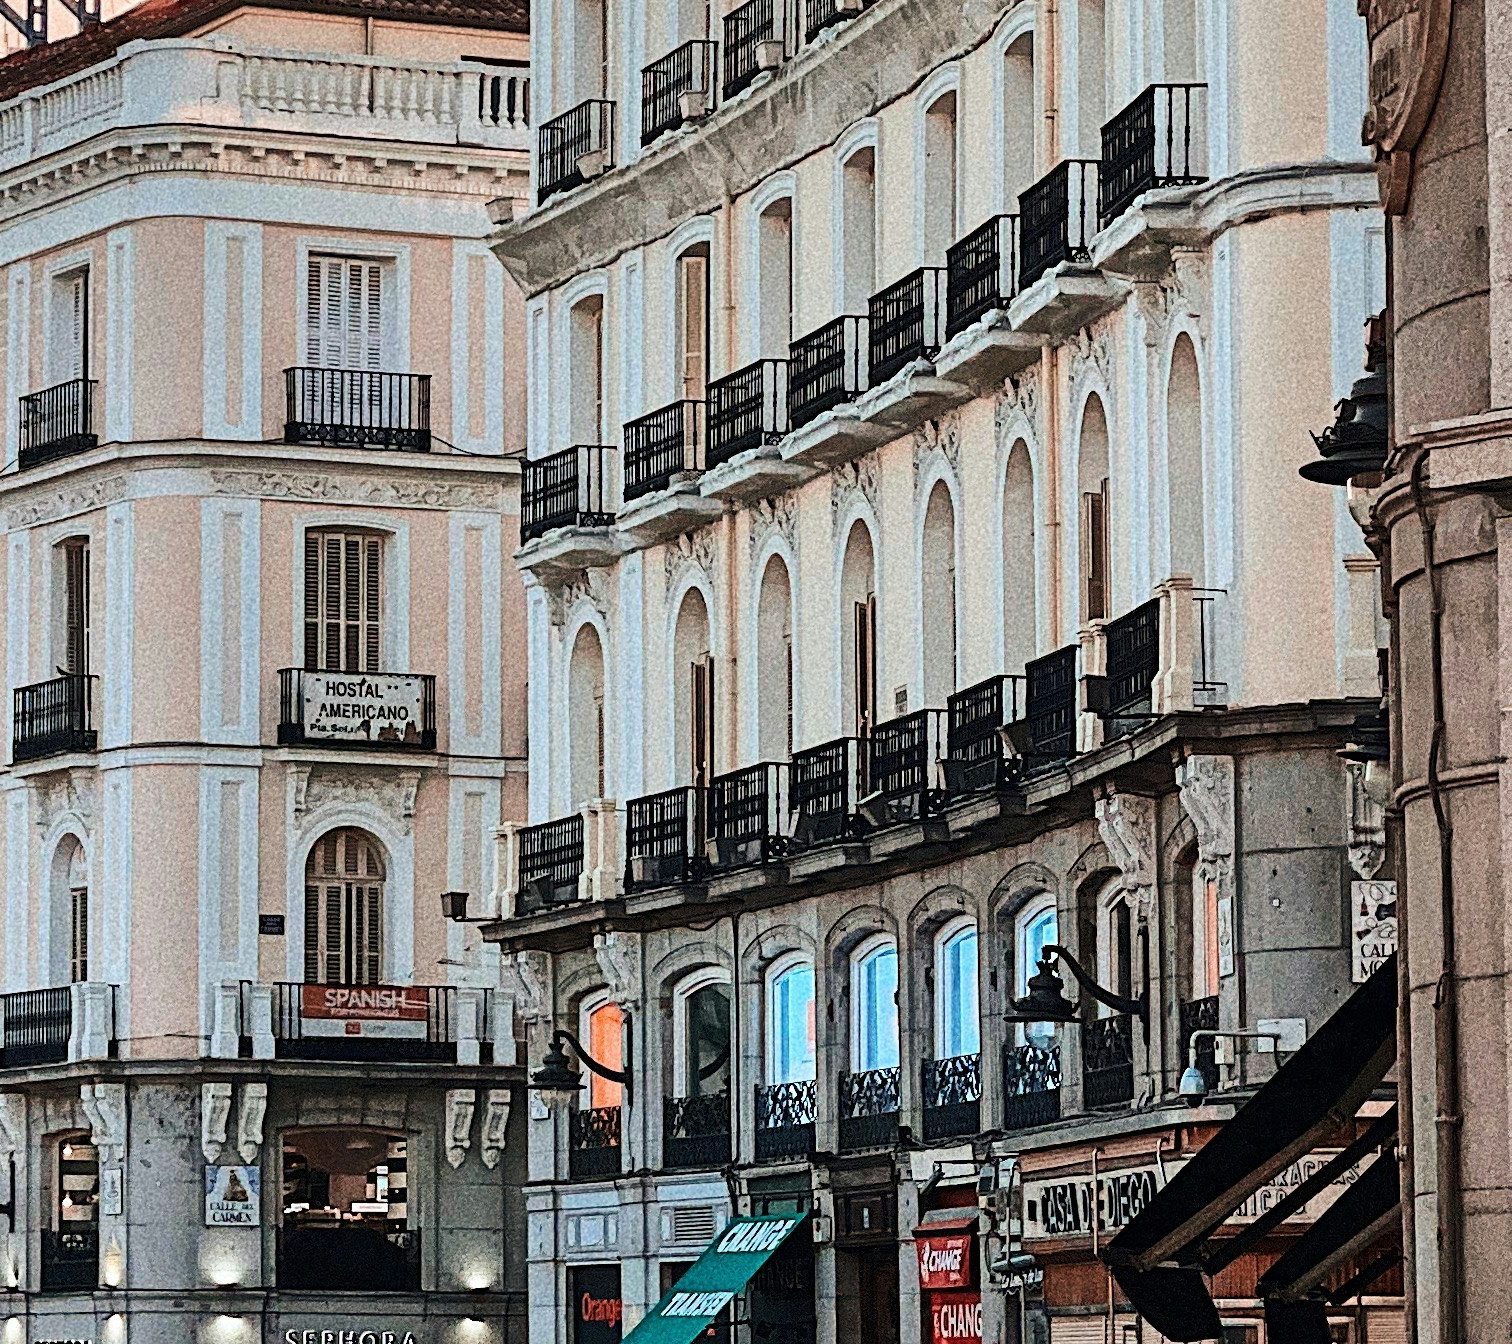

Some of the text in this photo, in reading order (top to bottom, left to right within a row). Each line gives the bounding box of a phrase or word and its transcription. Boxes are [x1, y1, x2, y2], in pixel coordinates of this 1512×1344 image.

[326, 680, 384, 698] HOSTAL
[319, 702, 409, 720] AMERICANO
[1361, 943, 1395, 958] CALL
[324, 988, 407, 1009] SPANISH
[1041, 1181, 1079, 1234] CASA
[1107, 1170, 1157, 1229] DIEGO
[212, 1212, 252, 1223] CARMEN
[717, 1219, 796, 1253] CHANGE
[582, 1292, 622, 1327] Orange
[940, 1303, 982, 1339] CHANG
